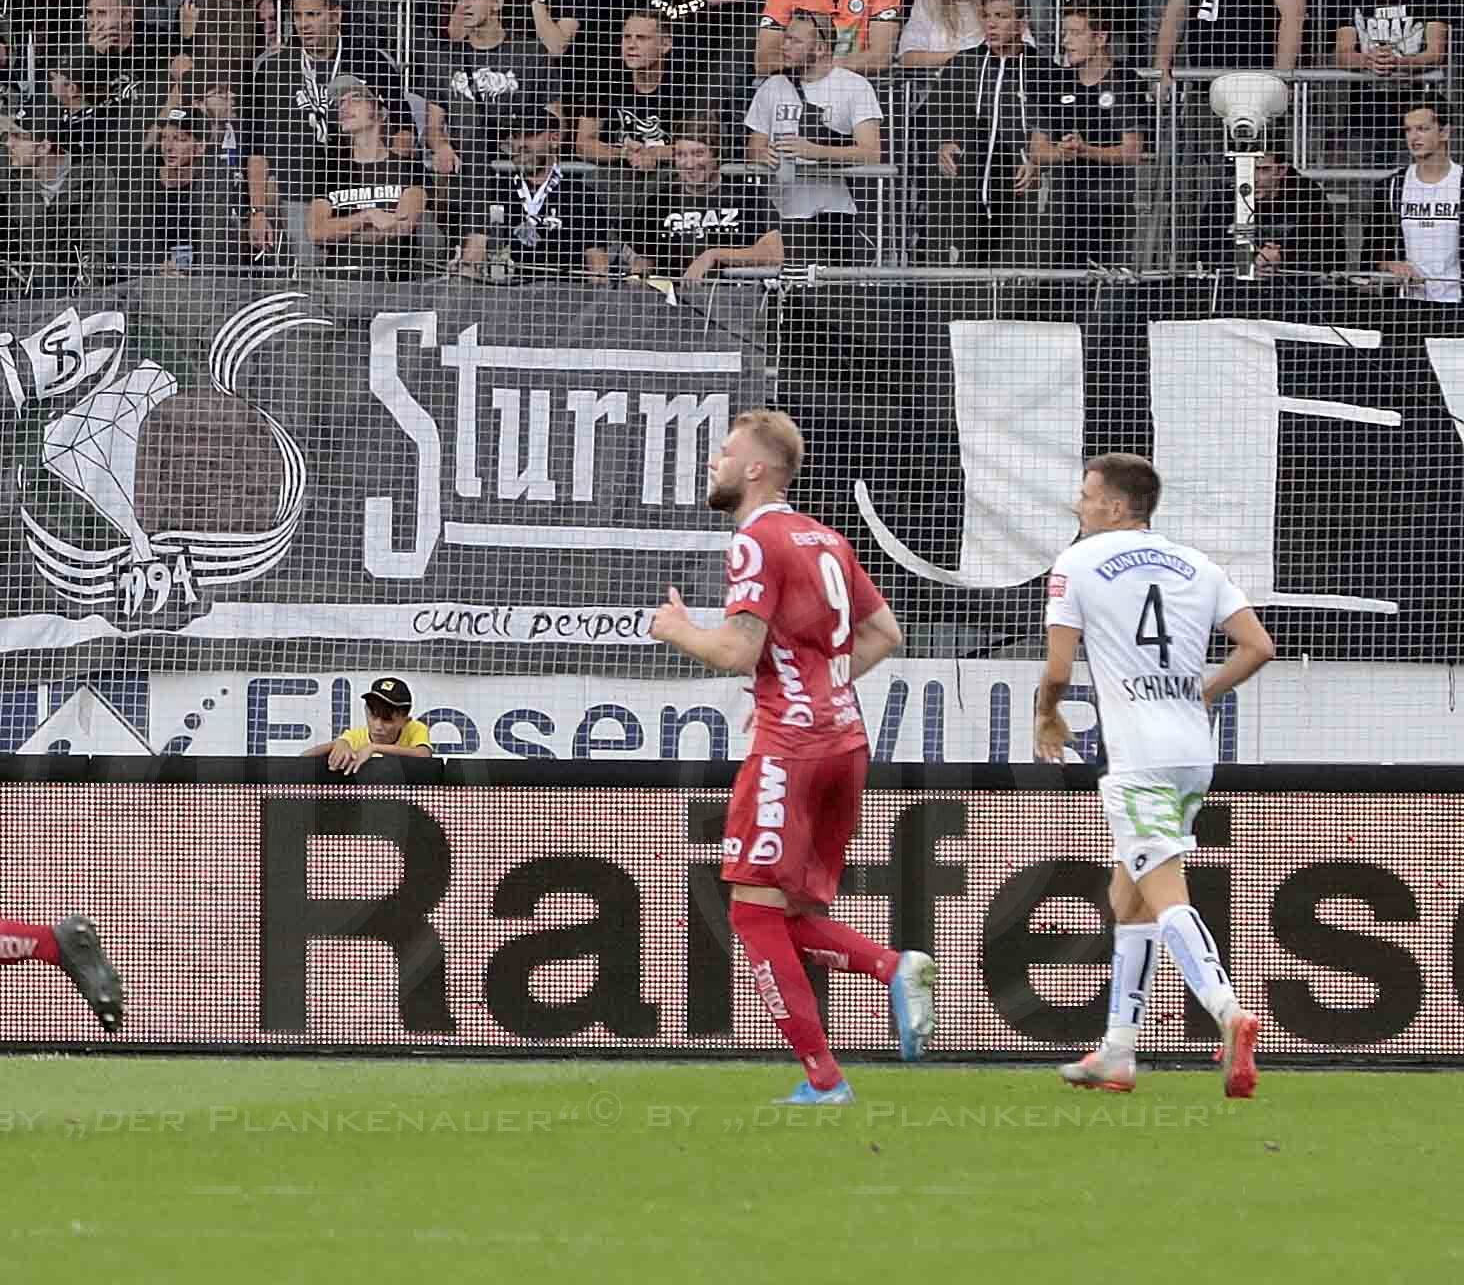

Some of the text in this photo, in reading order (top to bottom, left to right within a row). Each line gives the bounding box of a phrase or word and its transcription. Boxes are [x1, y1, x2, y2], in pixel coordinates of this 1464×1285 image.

[328, 187, 371, 205] STURM
[663, 207, 740, 233] GRAZ
[363, 310, 730, 579] Sturm
[855, 318, 1464, 615] JE
[816, 551, 851, 648] 9
[1099, 548, 1195, 584] PUNTIGAMER
[529, 609, 658, 641] perpet
[1136, 583, 1174, 669] 4
[246, 676, 730, 759] Flesen
